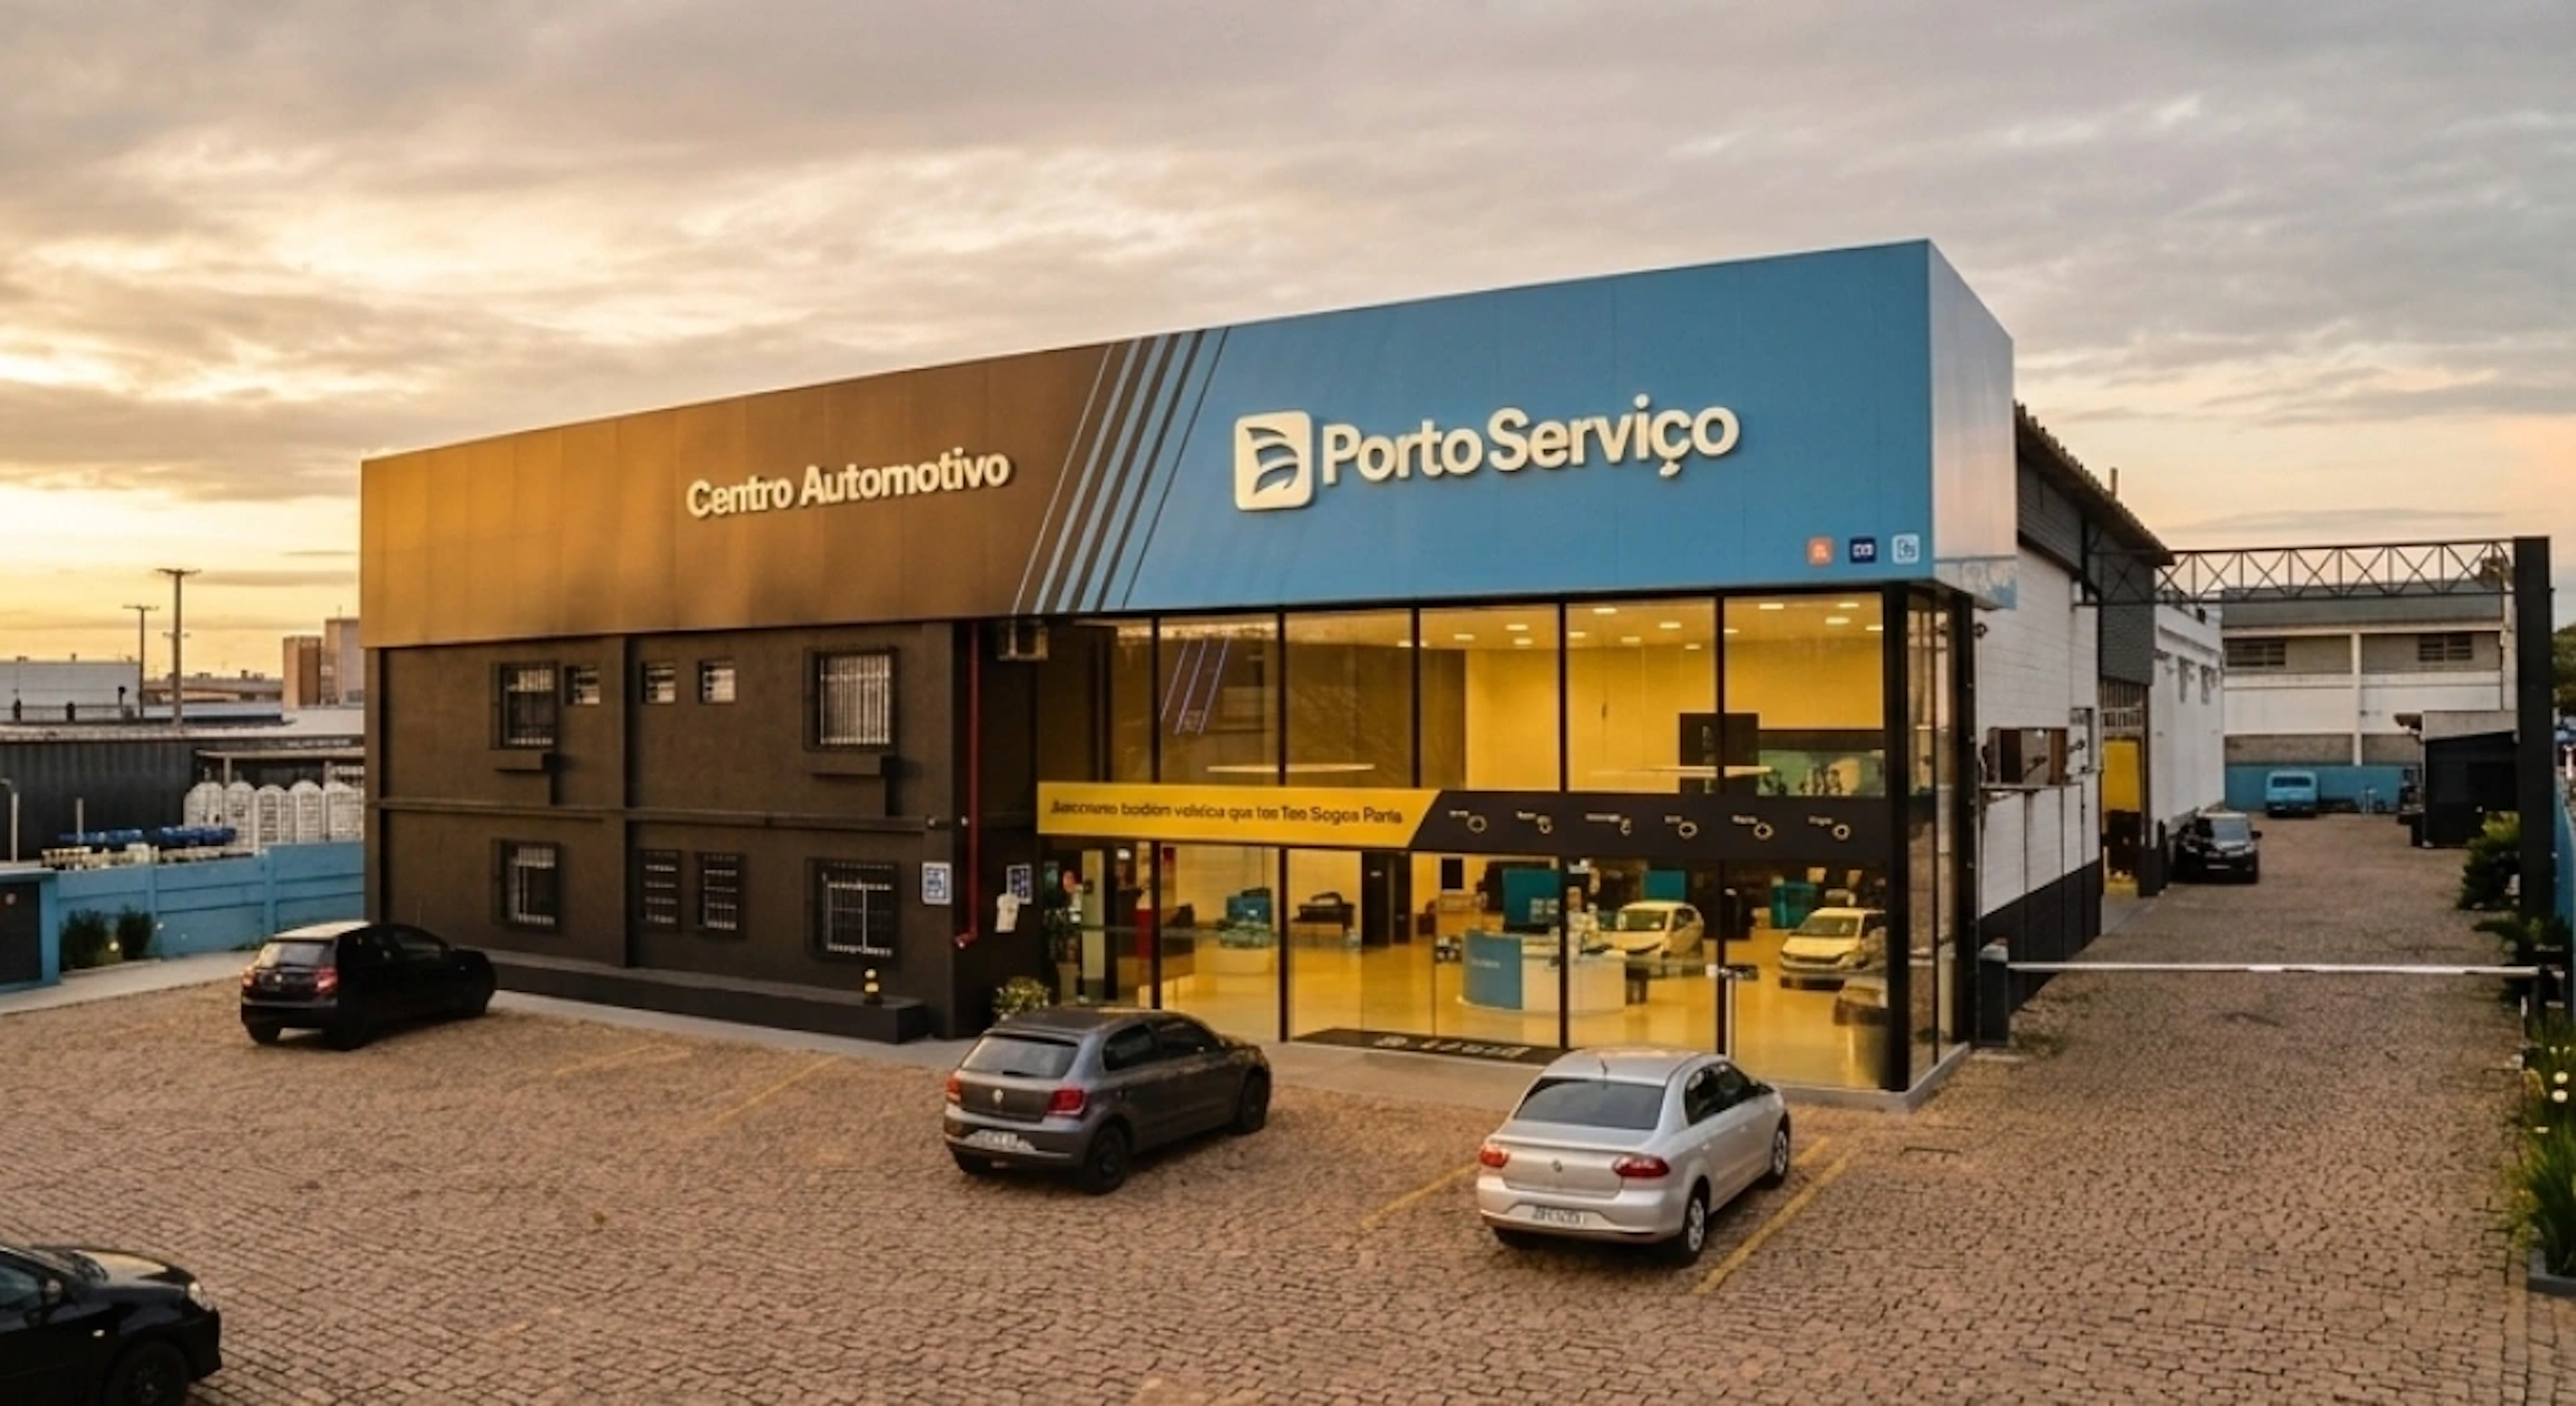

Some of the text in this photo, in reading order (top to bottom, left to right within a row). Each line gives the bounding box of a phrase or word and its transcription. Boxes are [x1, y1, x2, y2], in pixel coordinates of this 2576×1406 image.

[1322, 393, 1740, 486] Porto Serviço
[686, 447, 1012, 517] Centro Automotivo
